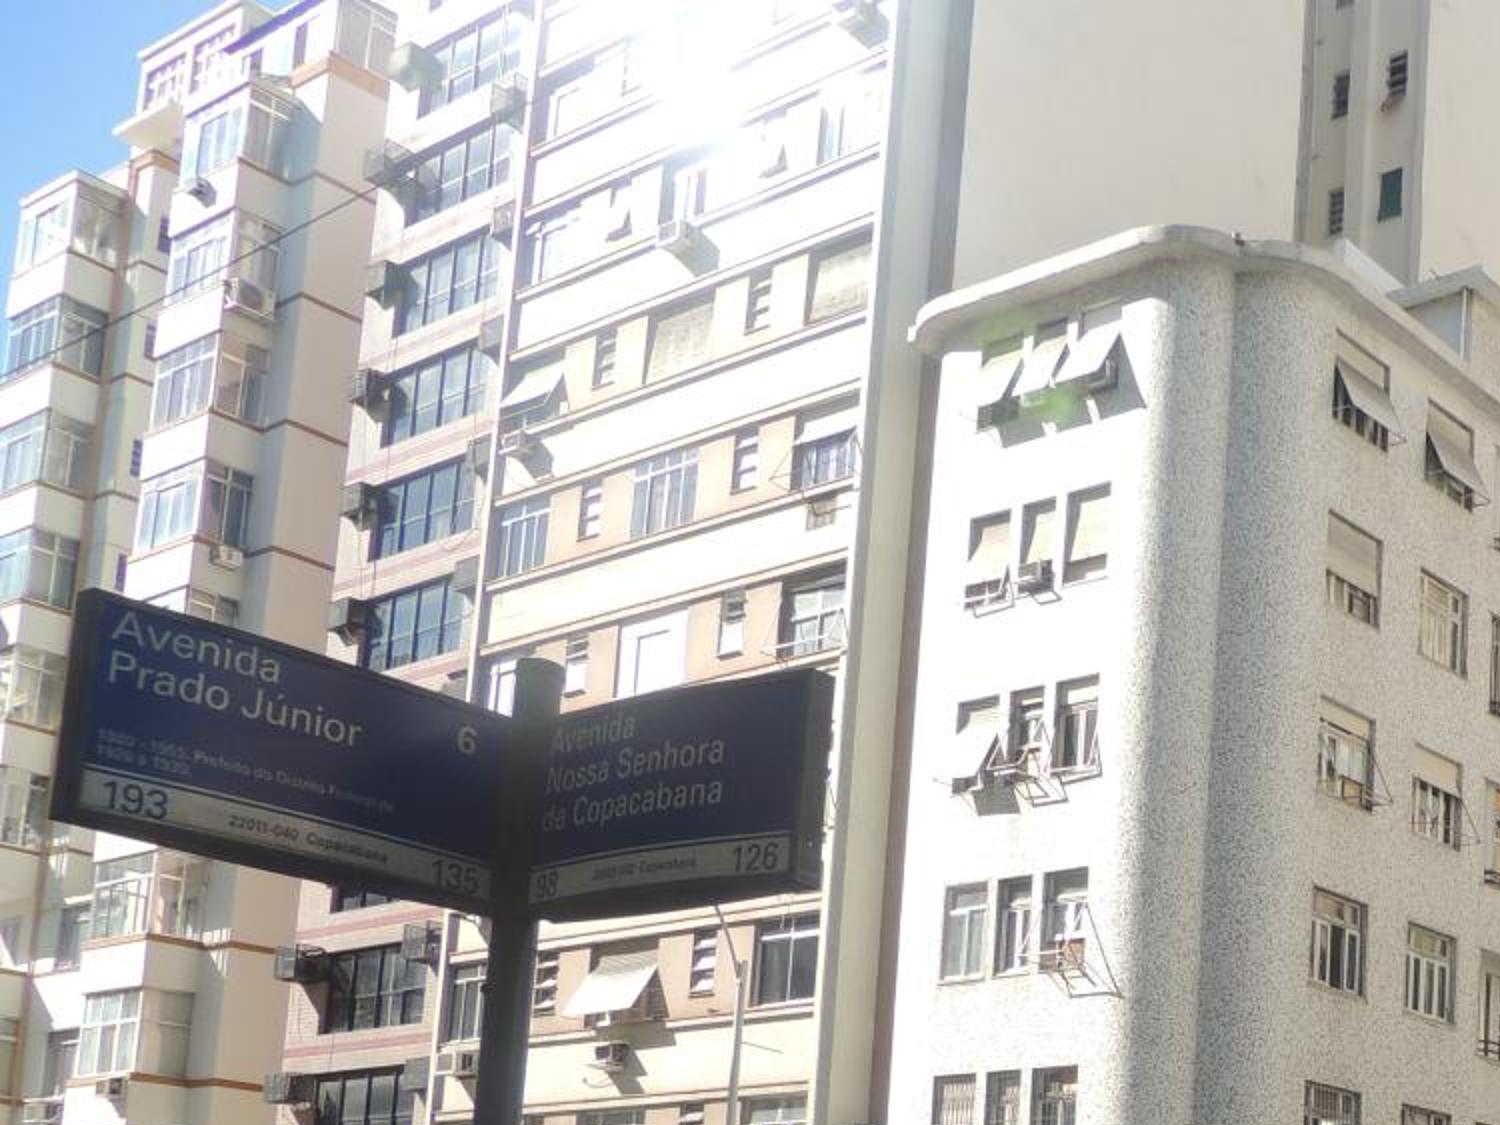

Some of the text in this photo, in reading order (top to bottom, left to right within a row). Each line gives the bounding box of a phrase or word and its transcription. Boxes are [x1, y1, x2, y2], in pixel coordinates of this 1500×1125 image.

[111, 611, 282, 684] Avenida
[107, 650, 231, 711] Prado
[241, 688, 364, 747] Júnior
[456, 726, 479, 756] 6
[551, 714, 637, 756] Avenida
[546, 738, 725, 794] Nossa Senhora
[103, 780, 169, 821] 193
[573, 780, 723, 828] Copacabana
[430, 858, 481, 895] 135
[731, 841, 779, 872] 126
[535, 872, 559, 899] 98
